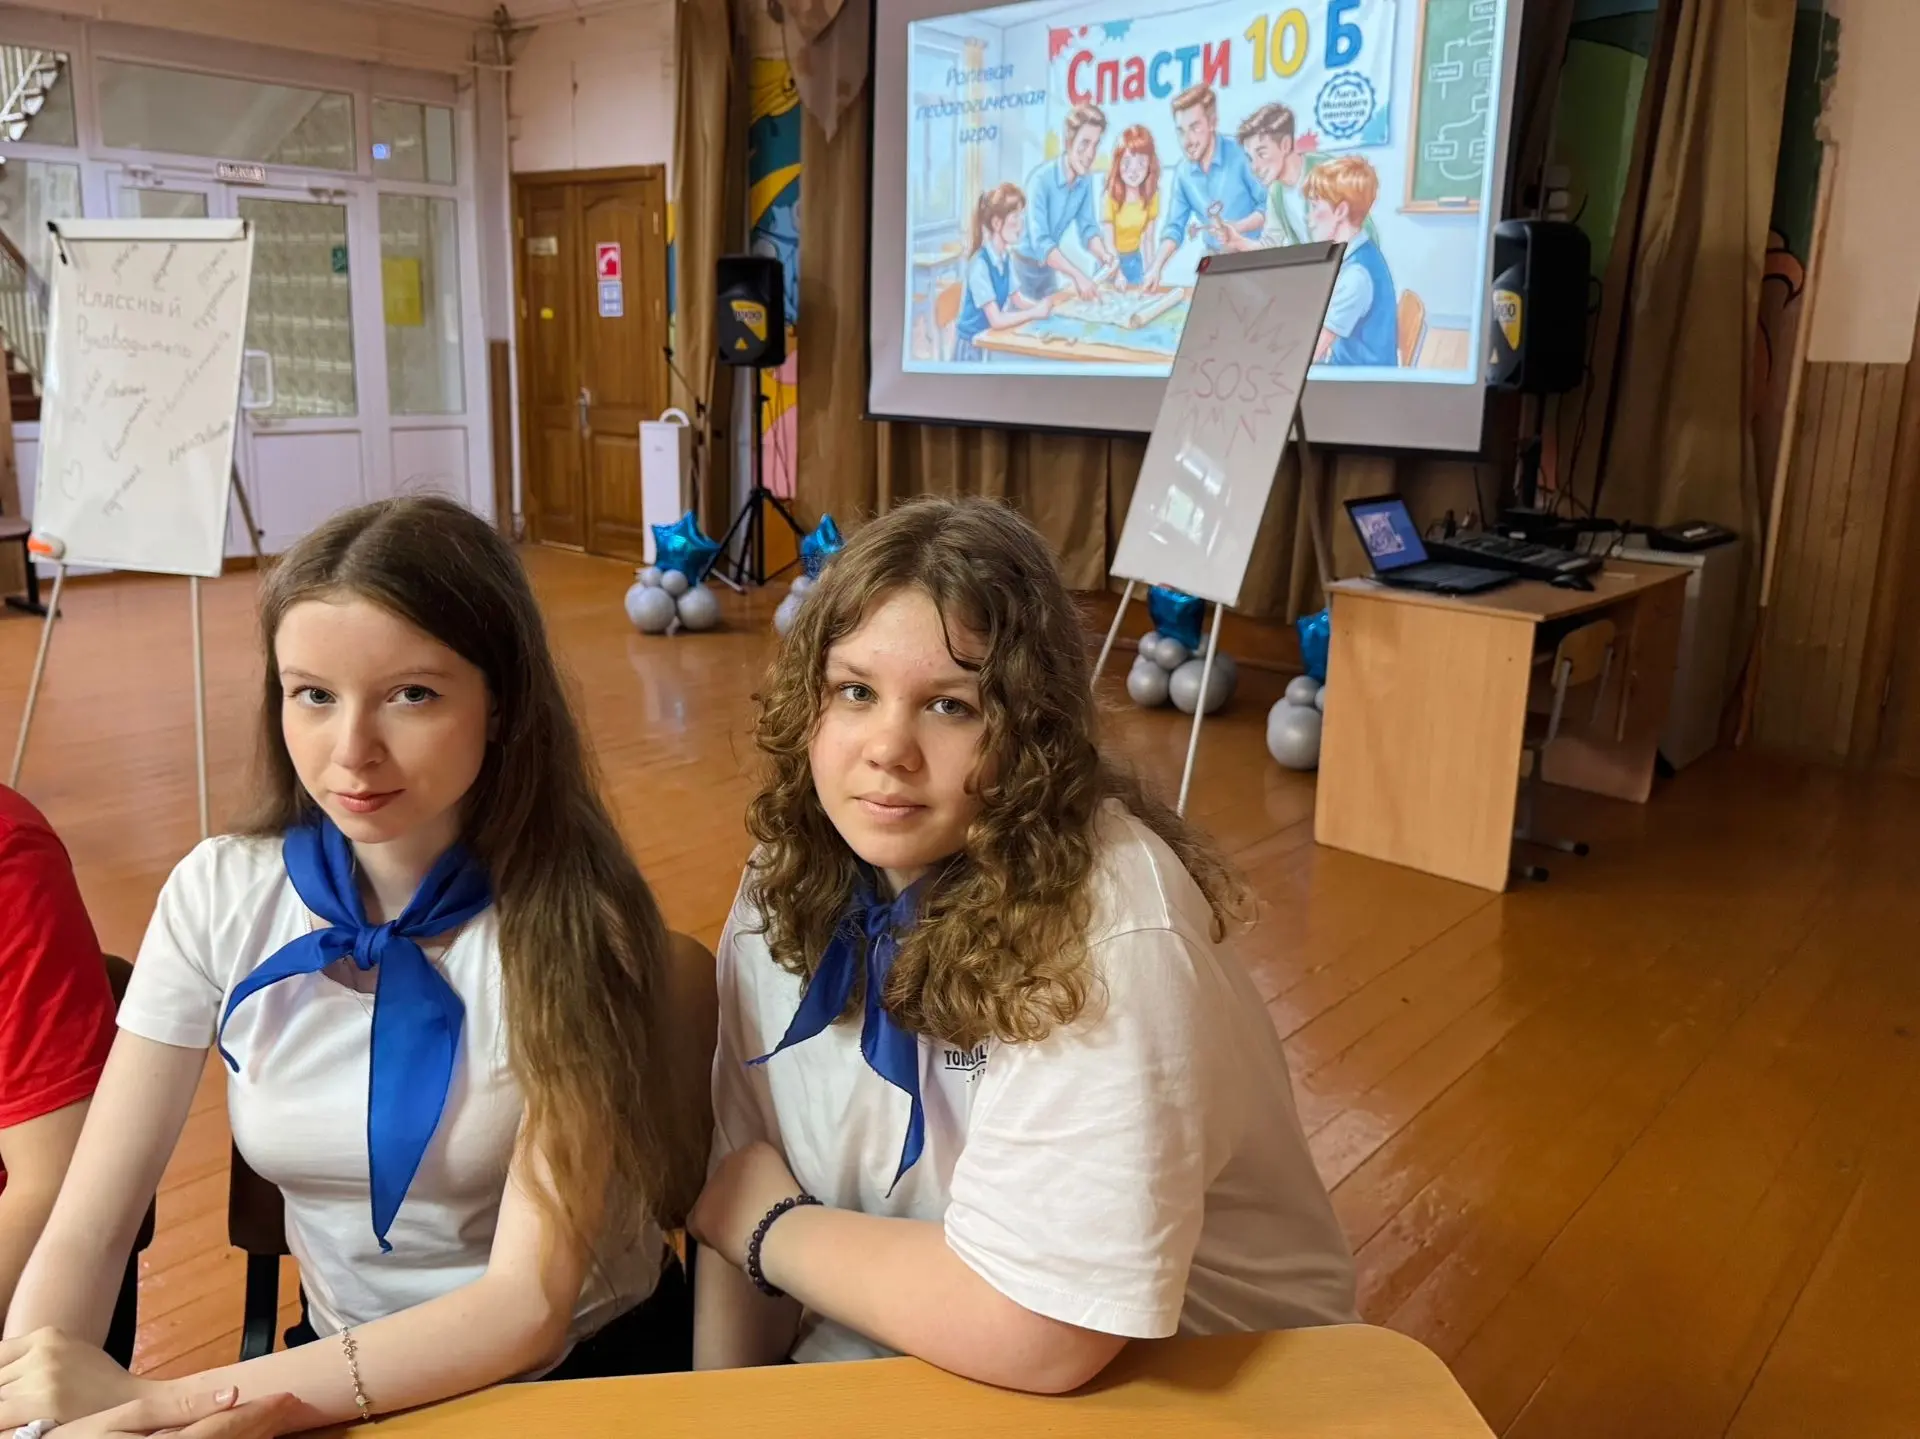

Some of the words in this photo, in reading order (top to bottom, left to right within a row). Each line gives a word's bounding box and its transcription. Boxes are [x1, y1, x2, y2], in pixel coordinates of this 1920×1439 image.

[1067, 39, 1231, 105] Спасти
[1244, 8, 1309, 82] 10
[1325, 0, 1362, 69] Б
